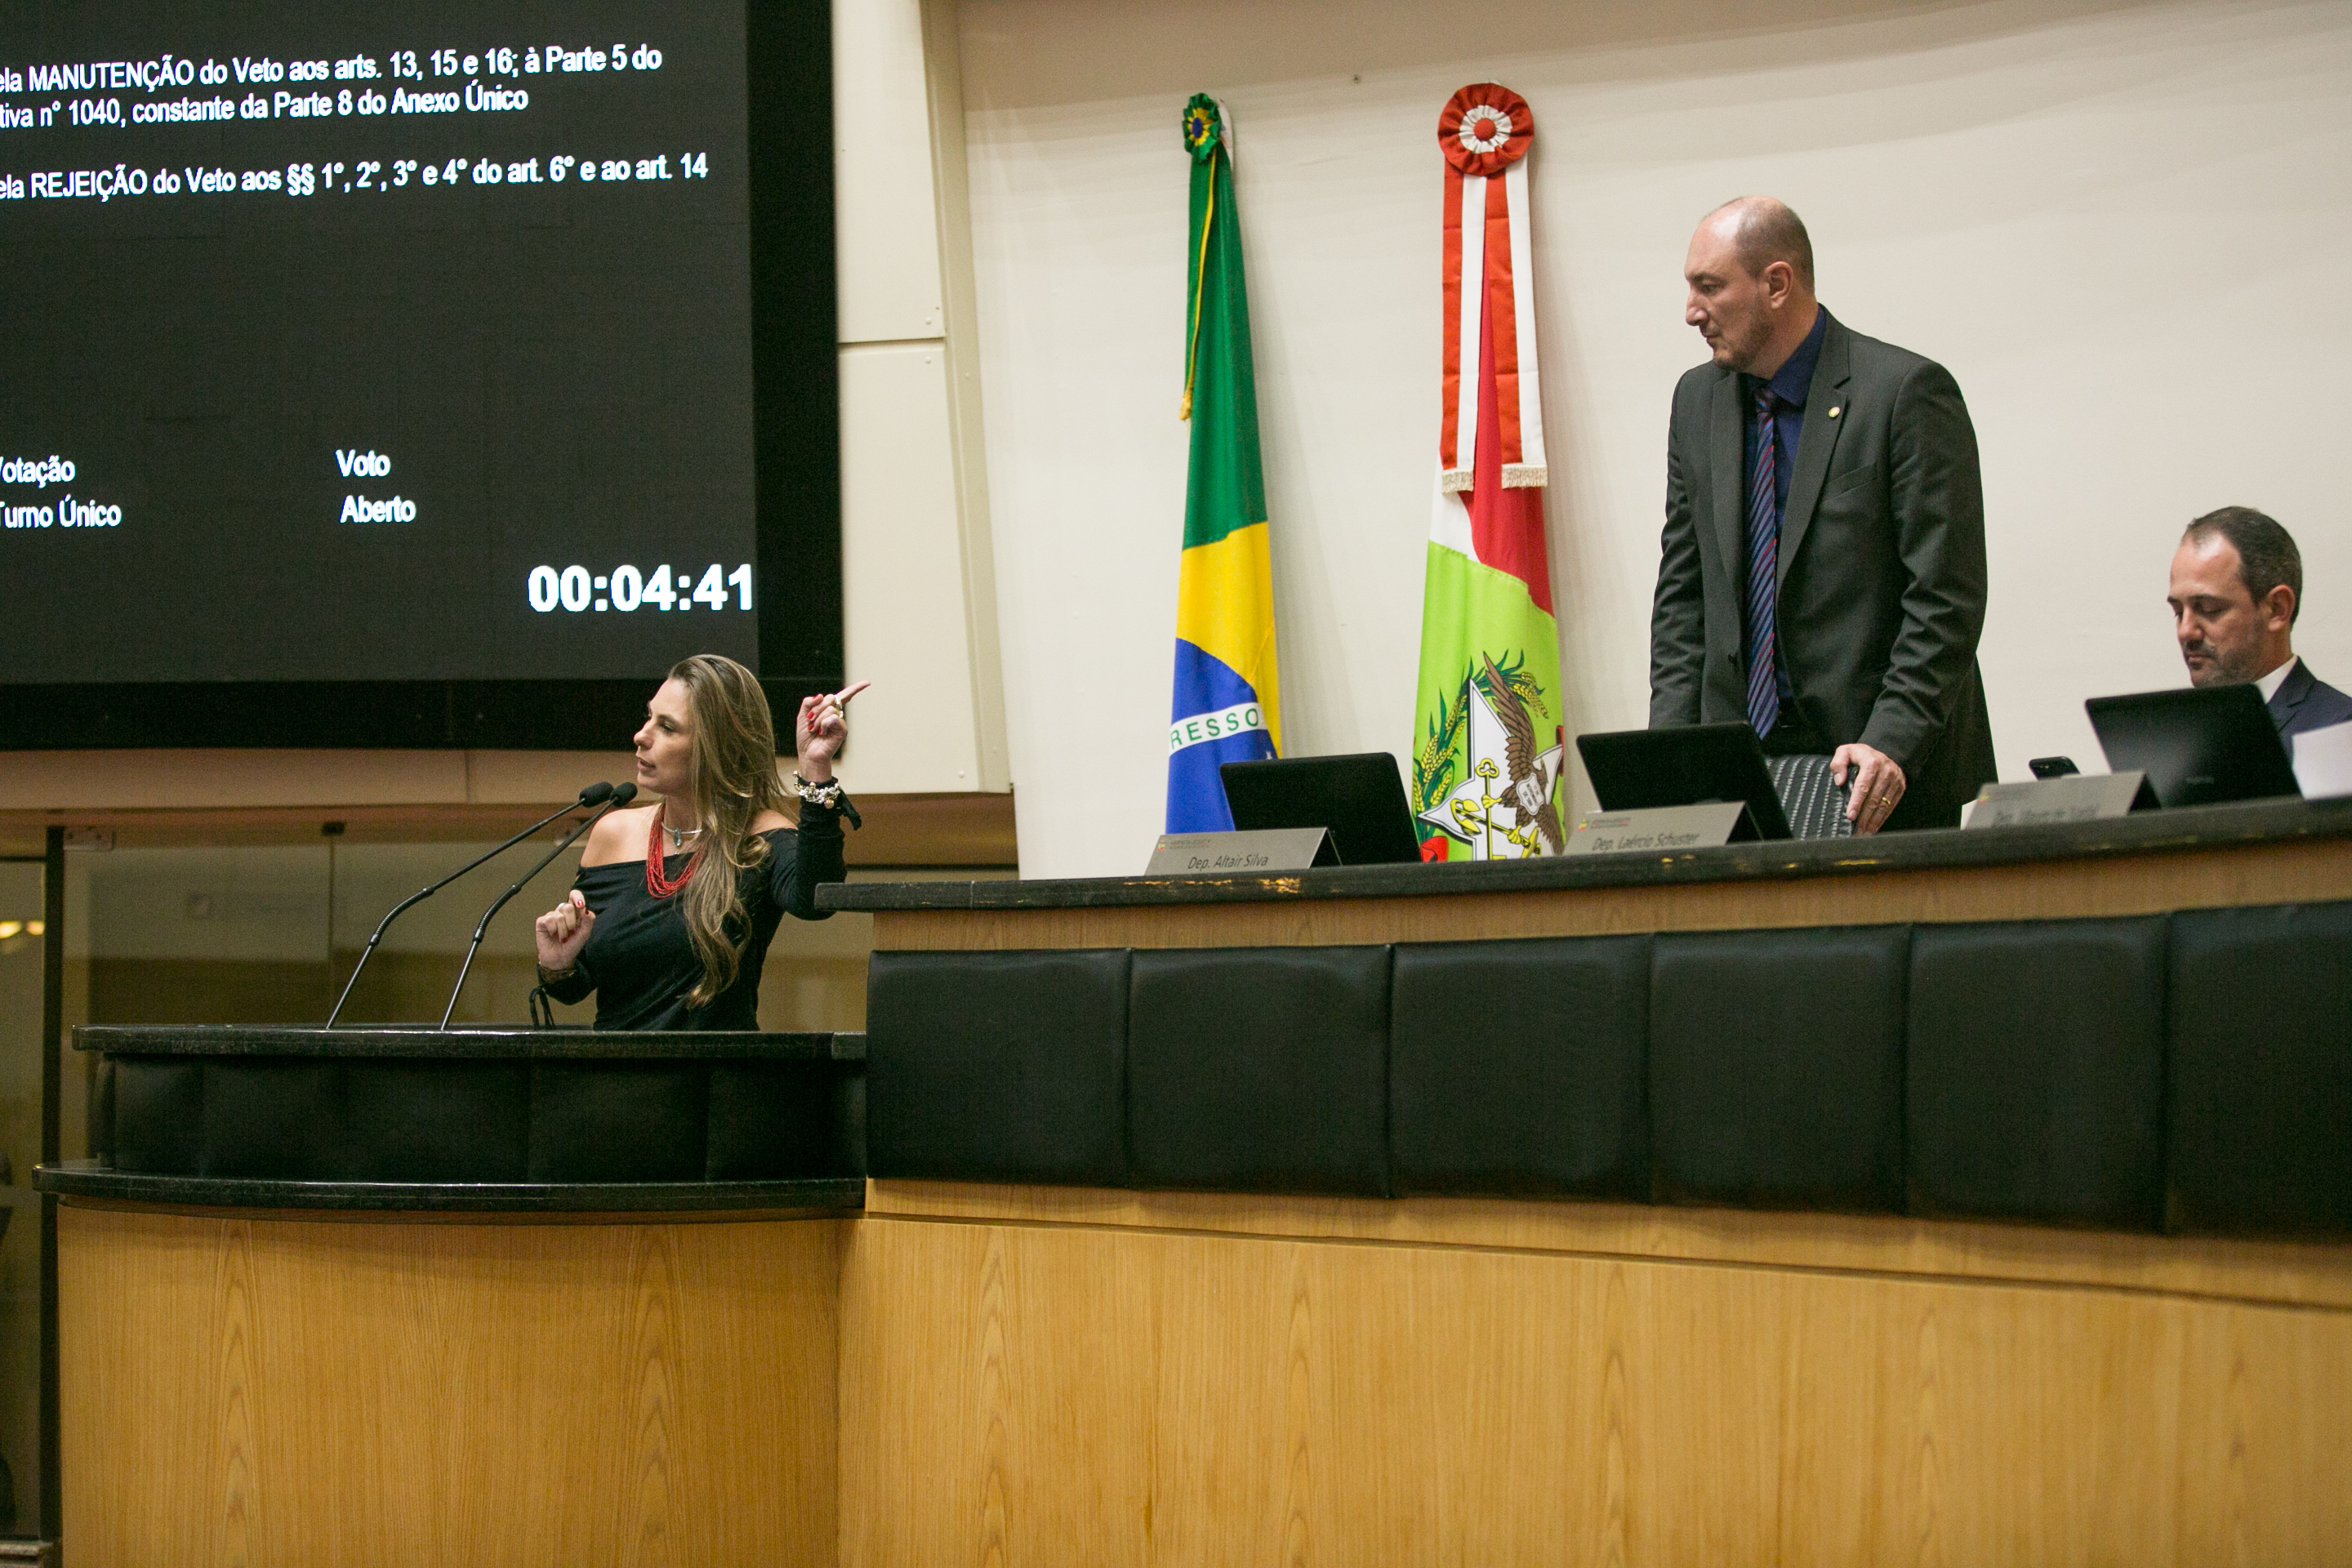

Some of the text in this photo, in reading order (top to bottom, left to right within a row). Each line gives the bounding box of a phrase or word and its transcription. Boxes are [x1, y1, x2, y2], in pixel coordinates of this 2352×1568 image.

[28, 55, 194, 92] MANUTENÇÃO
[198, 58, 228, 85] do
[231, 56, 284, 83] Veto
[288, 60, 330, 82] aos
[334, 54, 382, 80] arts.
[390, 51, 423, 80] 13,
[430, 49, 458, 76] 15
[462, 55, 479, 75] e
[484, 47, 519, 78] 16;
[524, 47, 541, 74] à
[545, 46, 607, 73] Parte
[612, 43, 628, 71] 5
[631, 42, 663, 70] do
[68, 98, 127, 128] 1040,
[132, 95, 235, 123] constante
[239, 92, 269, 119] da
[274, 91, 333, 118] Parte
[337, 88, 354, 116] 8
[357, 88, 387, 115] do
[390, 87, 461, 114] Anexo
[465, 79, 529, 112] Único
[30, 163, 148, 202] REJEIÇÃO
[152, 167, 181, 194] do
[184, 167, 237, 194] Veto
[241, 170, 283, 191] aos
[287, 163, 315, 197] §§
[422, 165, 439, 185] e
[472, 157, 503, 185] do
[507, 157, 544, 183] art.
[579, 160, 597, 181] e
[600, 159, 631, 181] ao
[635, 154, 673, 180] art.
[679, 152, 709, 179] 14
[0, 455, 76, 488] otação
[335, 448, 391, 477] Voto
[59, 493, 122, 528] Único
[340, 494, 417, 523] Aberto
[528, 564, 752, 612] 00:04:41
[1187, 853, 1269, 871] Dep. Altair Silva
